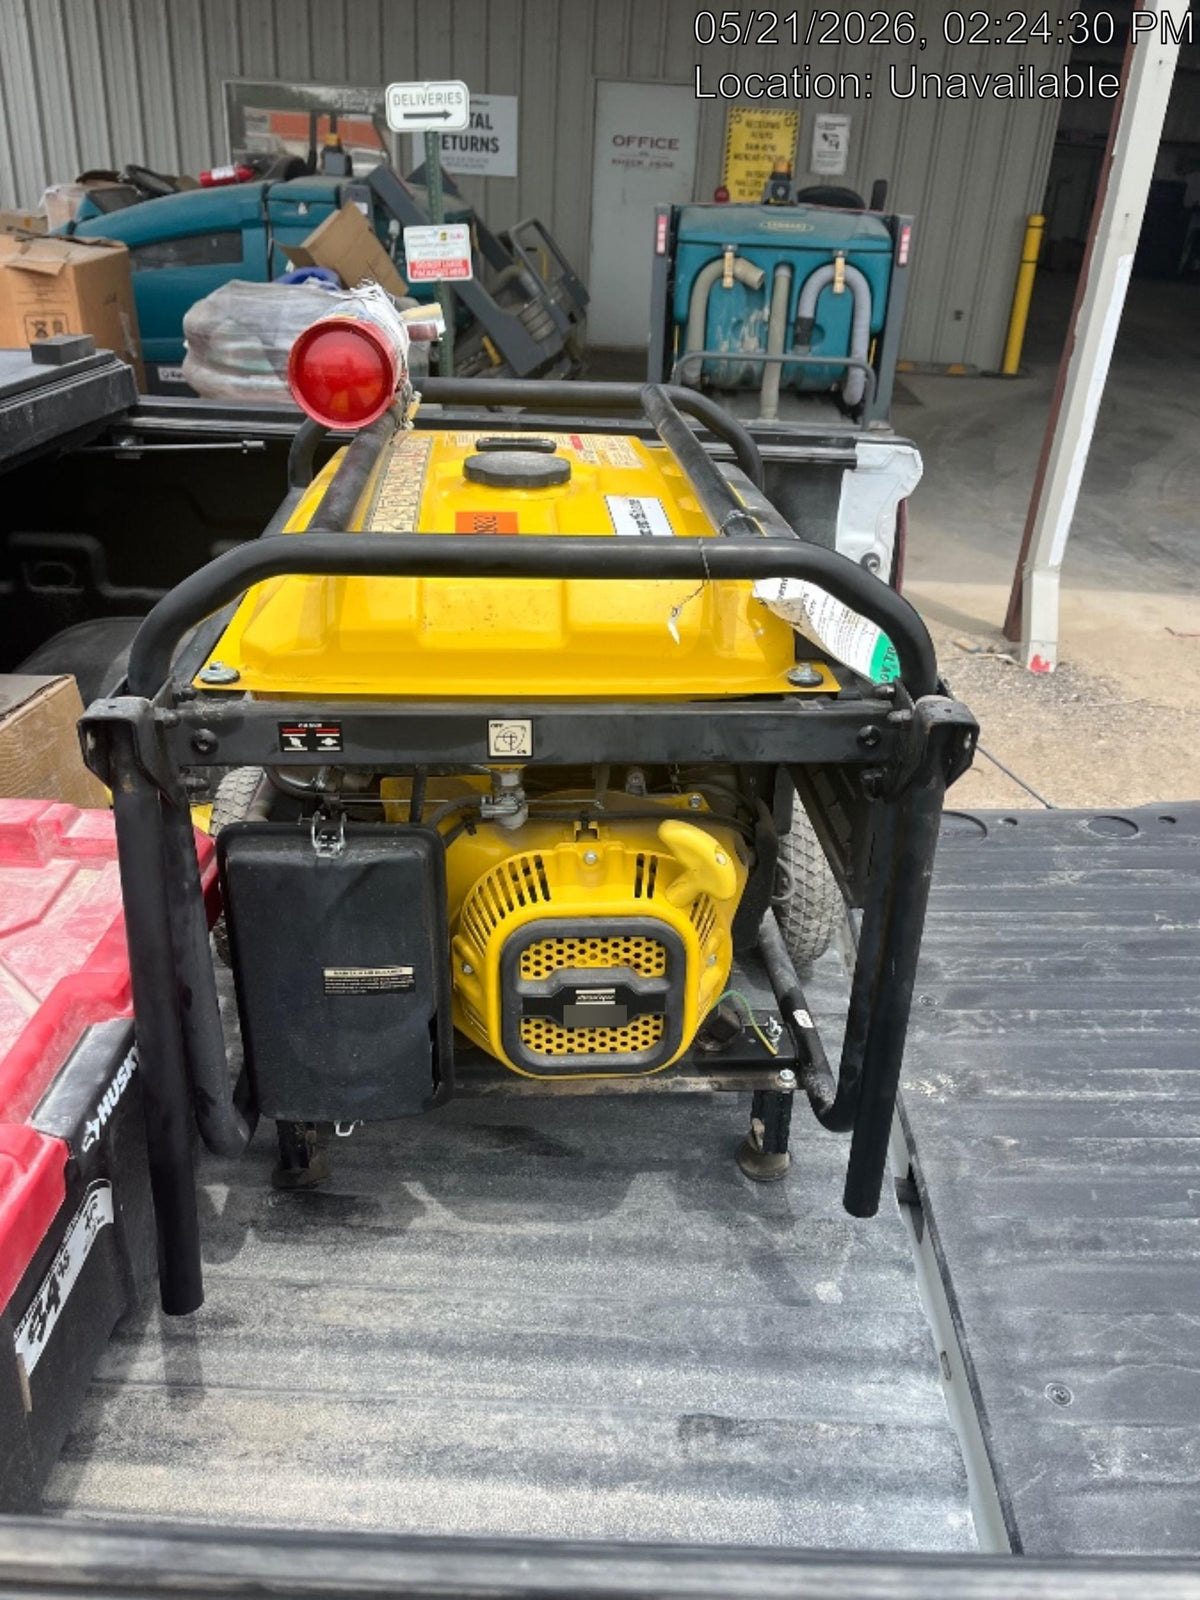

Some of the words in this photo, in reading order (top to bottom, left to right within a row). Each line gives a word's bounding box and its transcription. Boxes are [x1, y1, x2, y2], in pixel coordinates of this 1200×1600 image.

[393, 92, 463, 106] DELIVERIES
[469, 111, 493, 131] TAL
[441, 134, 500, 154] ETURNS
[612, 134, 681, 151] OFFICE
[97, 1042, 140, 1126] HUSK
